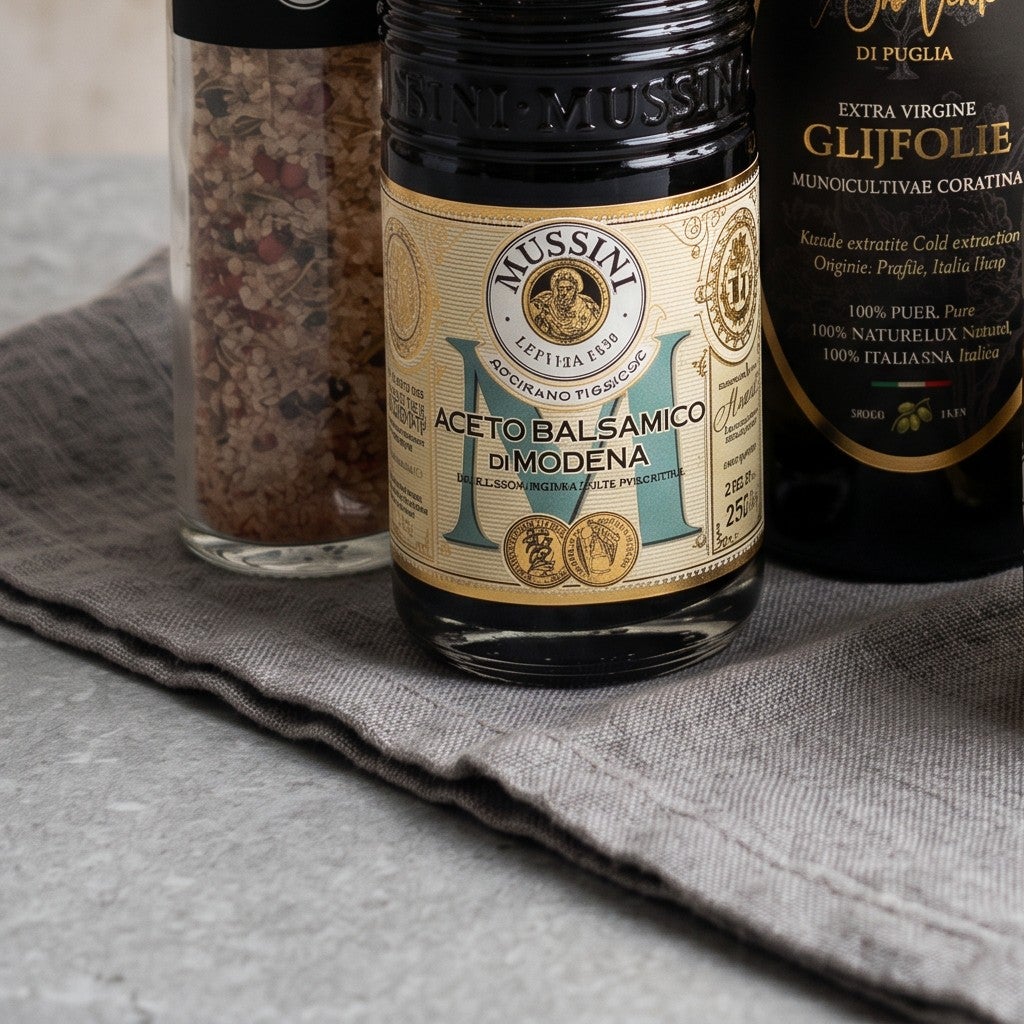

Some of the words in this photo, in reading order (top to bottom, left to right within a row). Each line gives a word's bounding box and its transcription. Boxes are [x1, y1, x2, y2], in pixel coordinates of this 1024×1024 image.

[856, 46, 877, 61] DI
[882, 46, 954, 62] PUGLIA
[838, 102, 896, 119] EXTRA
[900, 101, 977, 119] VIRGINE
[803, 121, 1013, 169] GLIJFOLIE
[937, 170, 1024, 195] CORATINA
[847, 237, 909, 253] extratite
[913, 234, 949, 252] Cold
[952, 230, 1020, 250] extraction
[494, 230, 637, 295] MUSSINI
[850, 304, 886, 319] 100%
[944, 304, 975, 319] Pure
[812, 323, 847, 339] 100%
[852, 327, 957, 343] NATURELUX
[823, 347, 860, 363] 100%
[435, 406, 526, 443] ACETO
[532, 400, 706, 444] BALSAMICO
[489, 453, 509, 472] DI
[513, 444, 650, 474] MODENA
